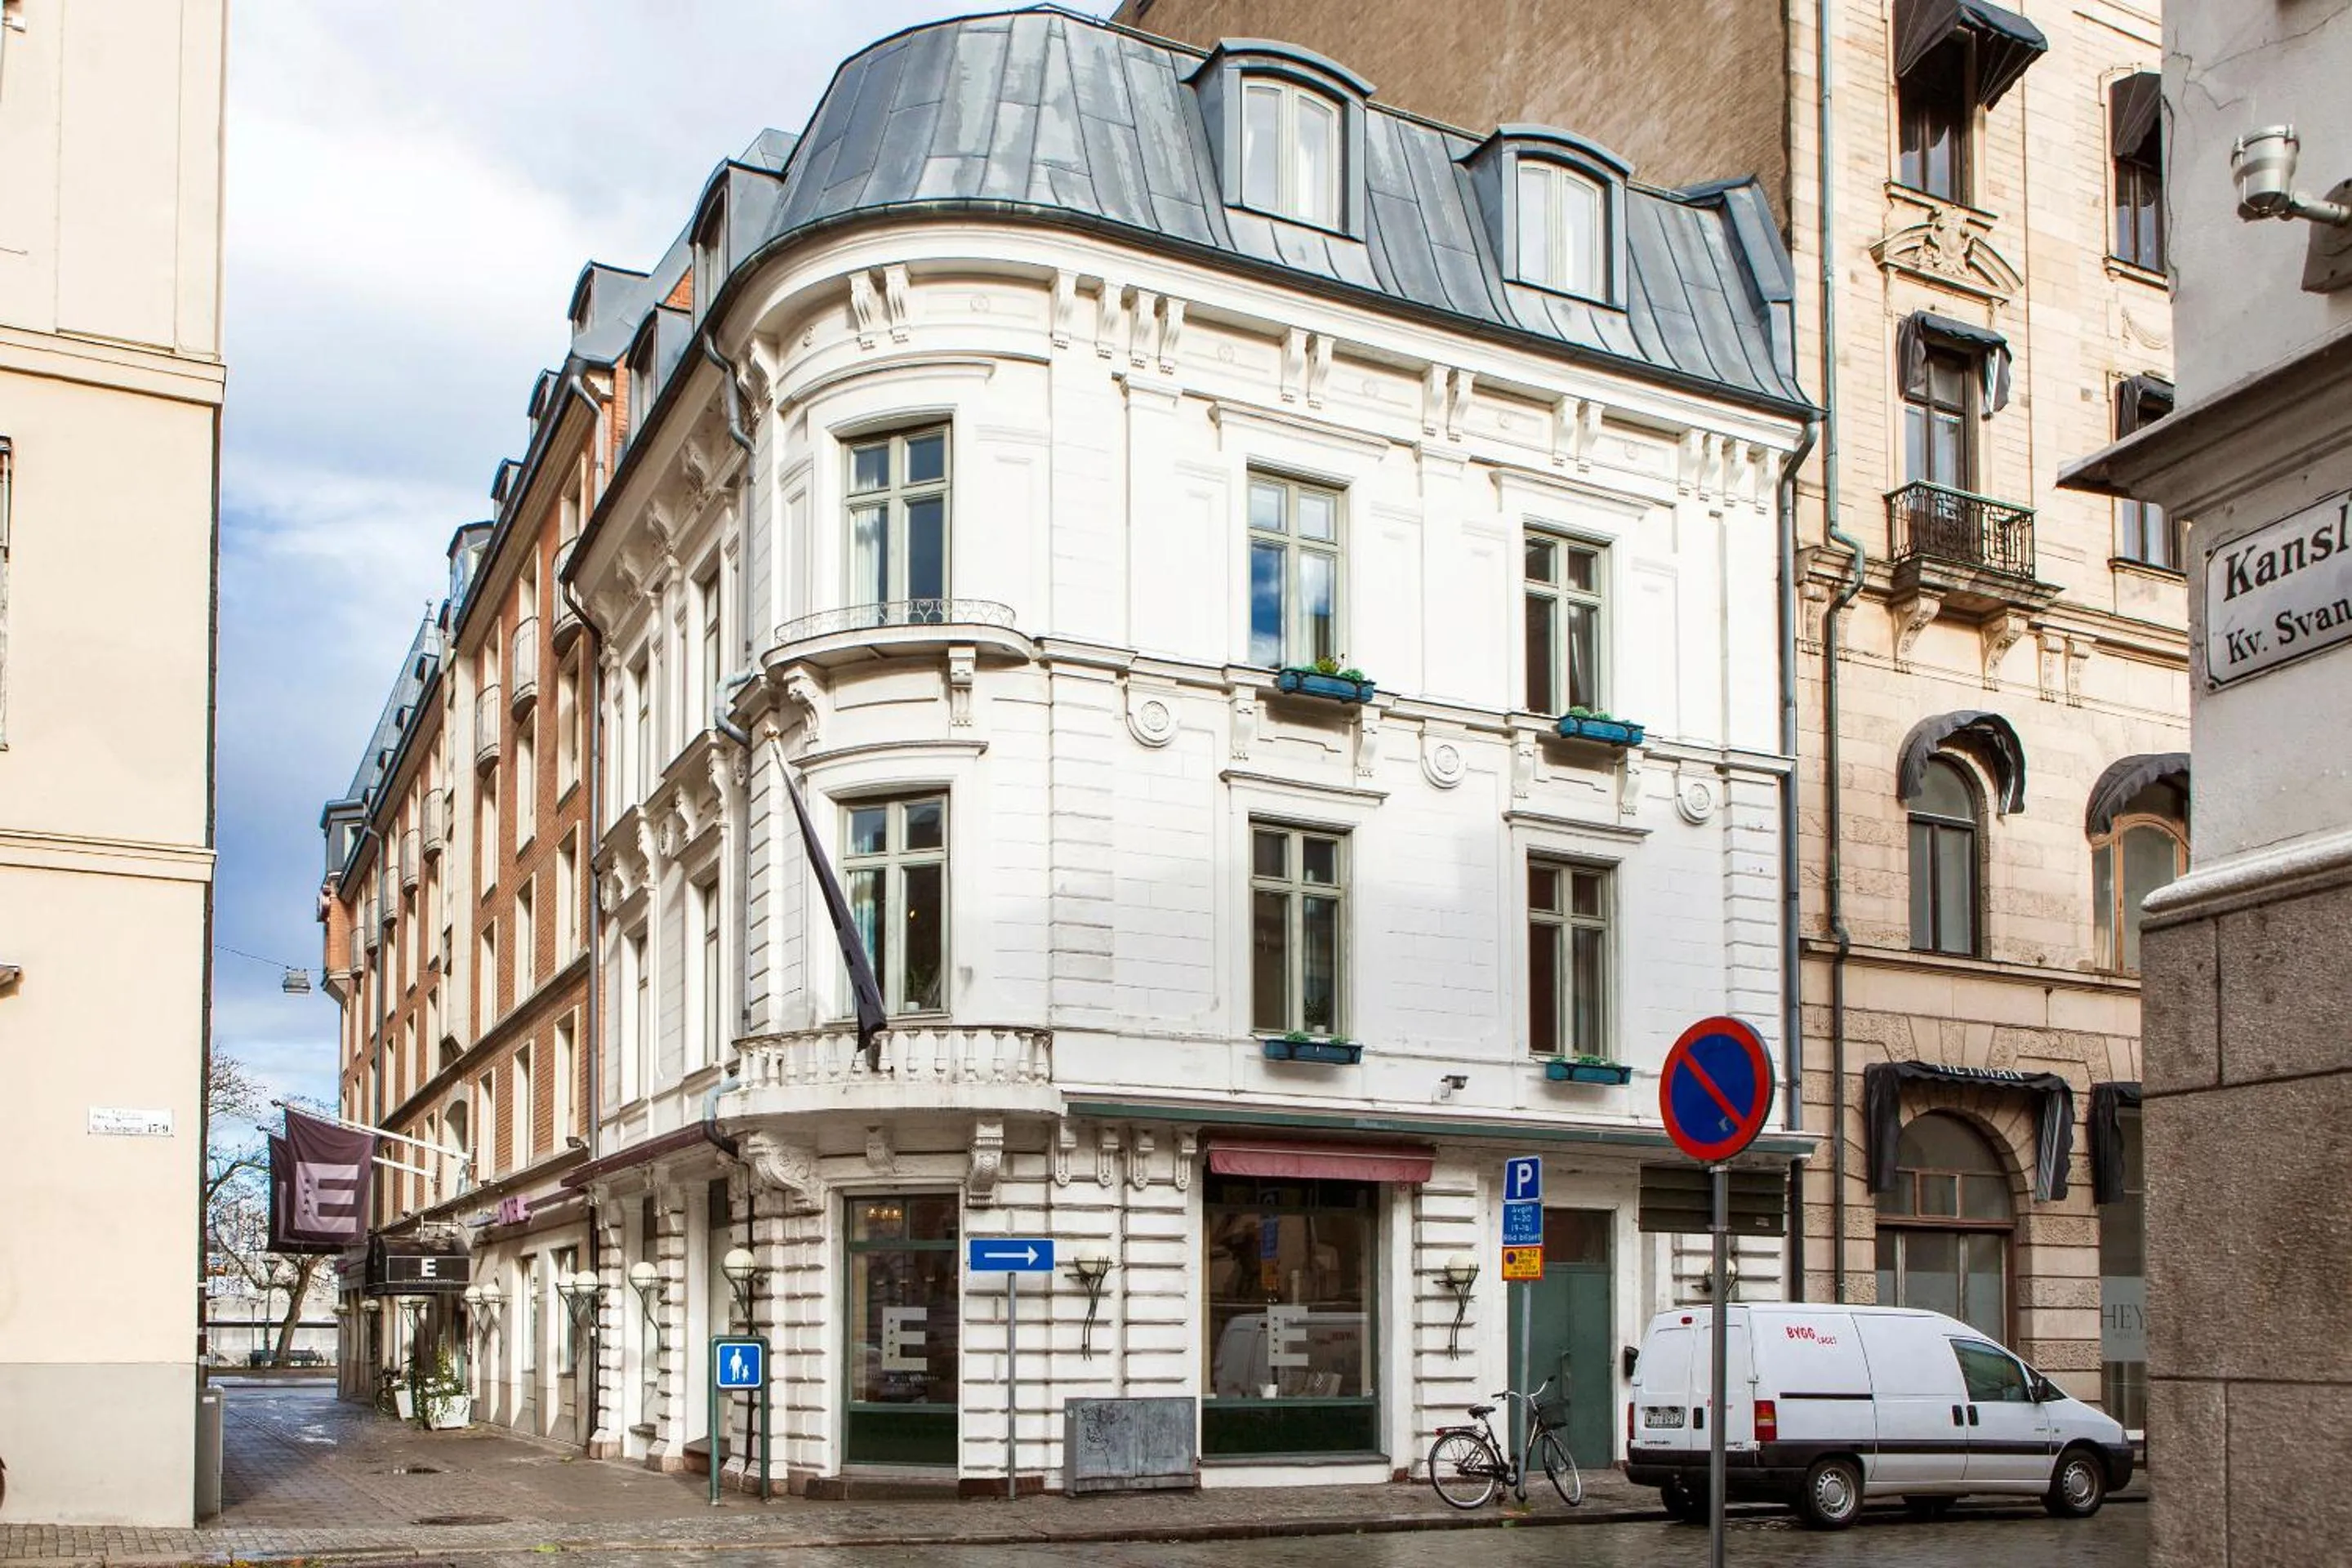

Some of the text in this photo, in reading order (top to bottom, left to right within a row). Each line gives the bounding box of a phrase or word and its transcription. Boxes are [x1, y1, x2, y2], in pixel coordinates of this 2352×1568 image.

[2223, 504, 2350, 602] Kansl
[2226, 598, 2352, 665] Kv. Svan
[295, 1161, 359, 1233] E
[1517, 1163, 1533, 1197] P
[421, 1258, 436, 1277] E
[882, 1307, 928, 1371] E
[1267, 1306, 1308, 1366] E
[1786, 1326, 1815, 1339] BYGG
